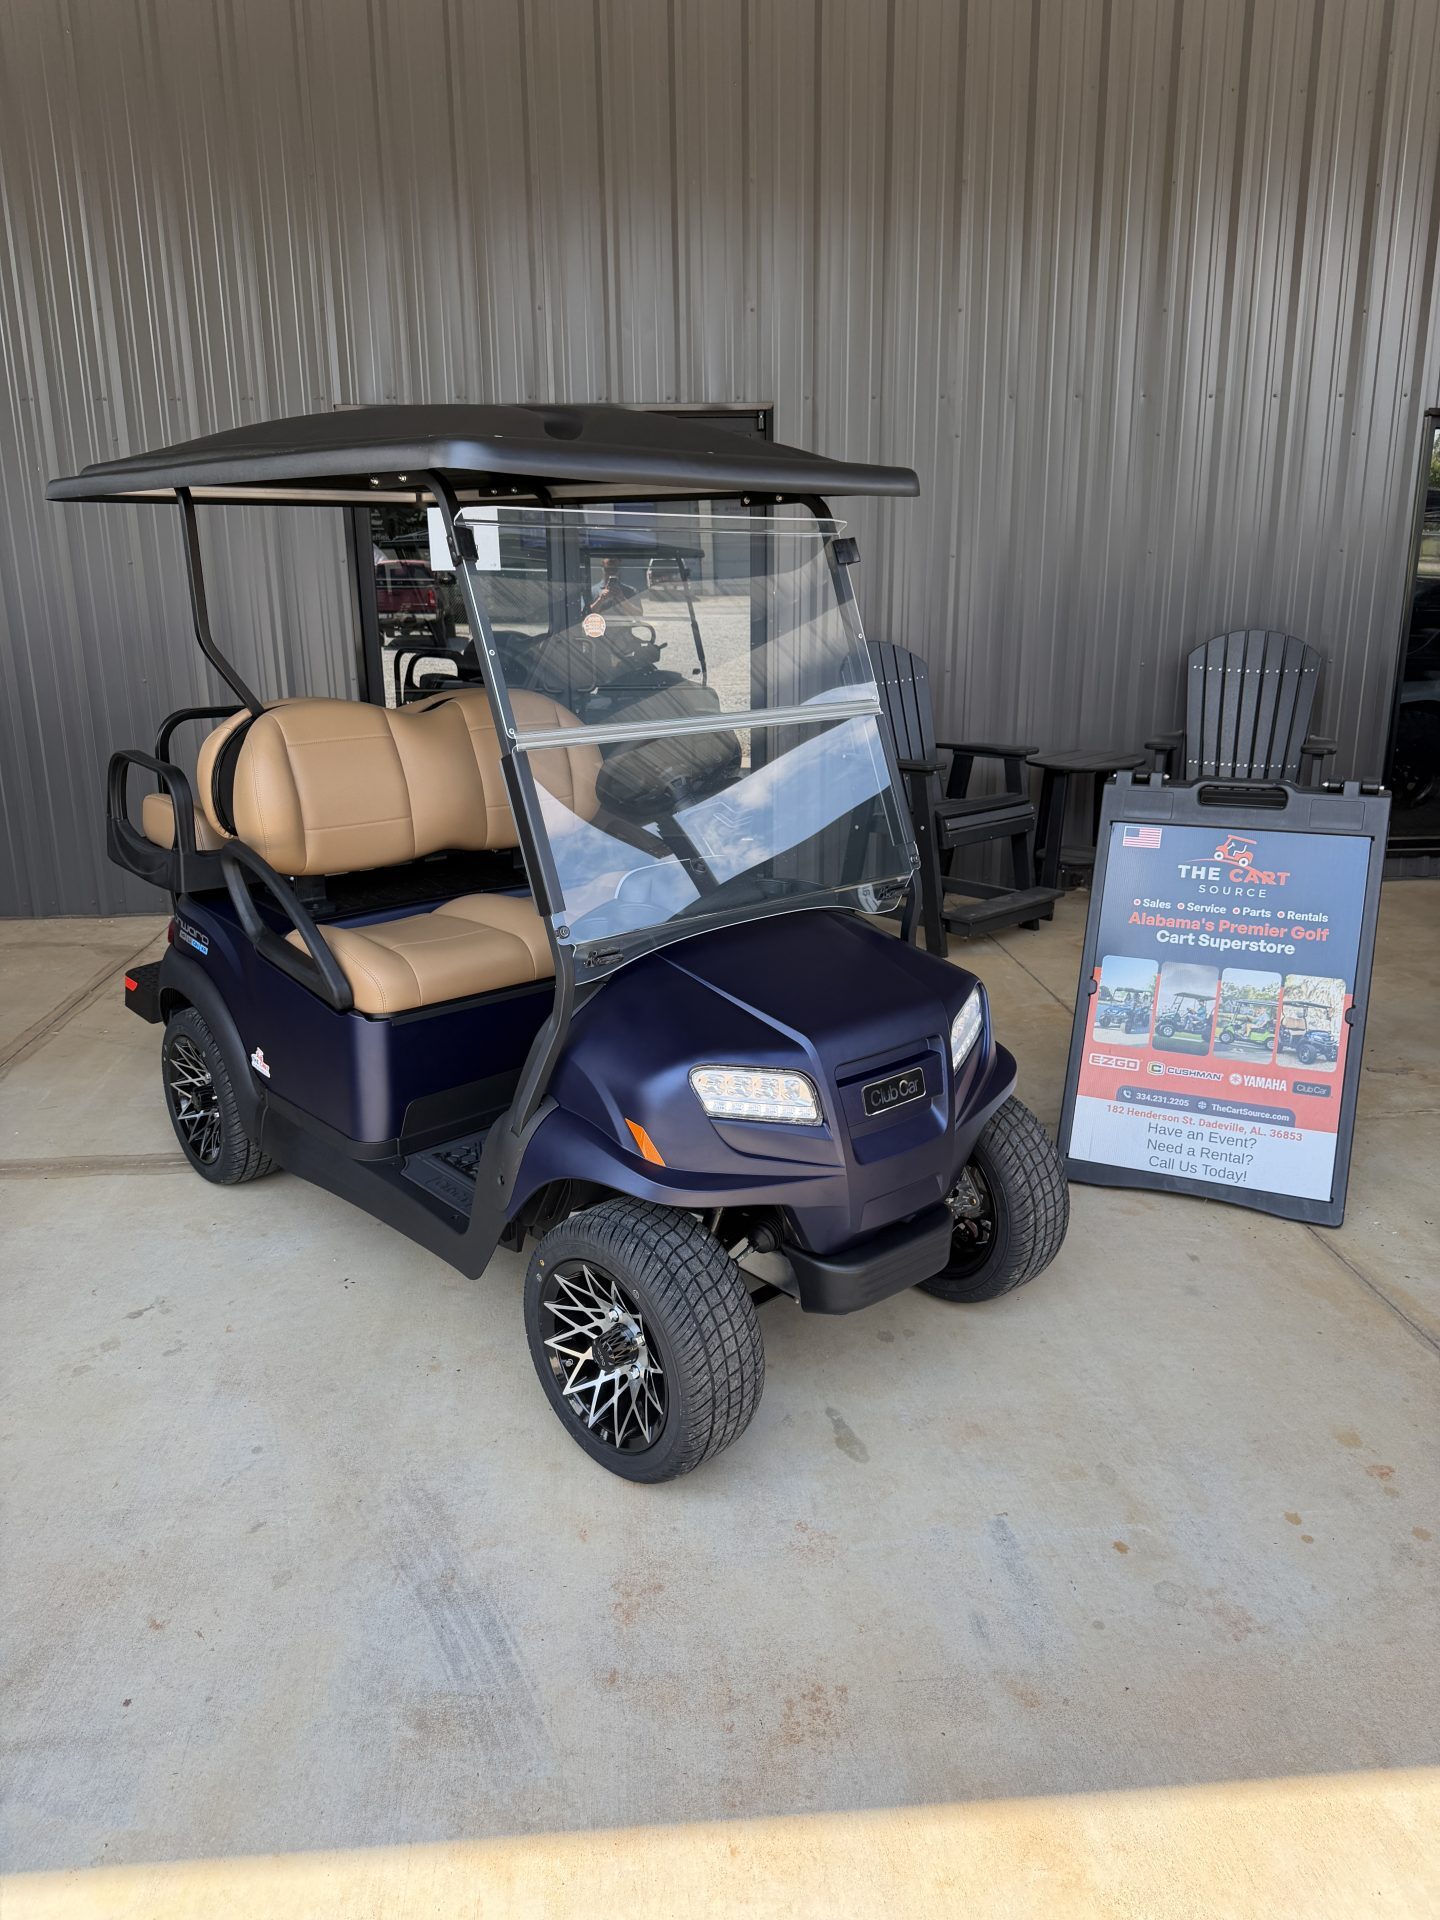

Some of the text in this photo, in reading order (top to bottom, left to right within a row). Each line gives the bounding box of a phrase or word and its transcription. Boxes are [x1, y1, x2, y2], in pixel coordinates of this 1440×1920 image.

[1177, 864, 1291, 886] THE CART
[1198, 884, 1267, 898] SOURCE
[1143, 898, 1329, 923] Sales Service Parts Rentals
[1128, 911, 1330, 942] Alabama's Premier Golf
[1156, 930, 1296, 955] Cart Superstore
[1167, 1067, 1222, 1081] CUSHMAN
[1243, 1075, 1288, 1091] YAMAHA
[871, 1080, 918, 1106] Club Car
[1135, 1092, 1290, 1121] 334.231.2205 TheCartSource.com
[1106, 1104, 1303, 1142] 182 Henderson St. Dadeville, AL. 36853
[1148, 1122, 1257, 1149] Have an Event?
[1147, 1139, 1254, 1166] Need a Rental?
[1148, 1155, 1247, 1183] Call Us Today!
